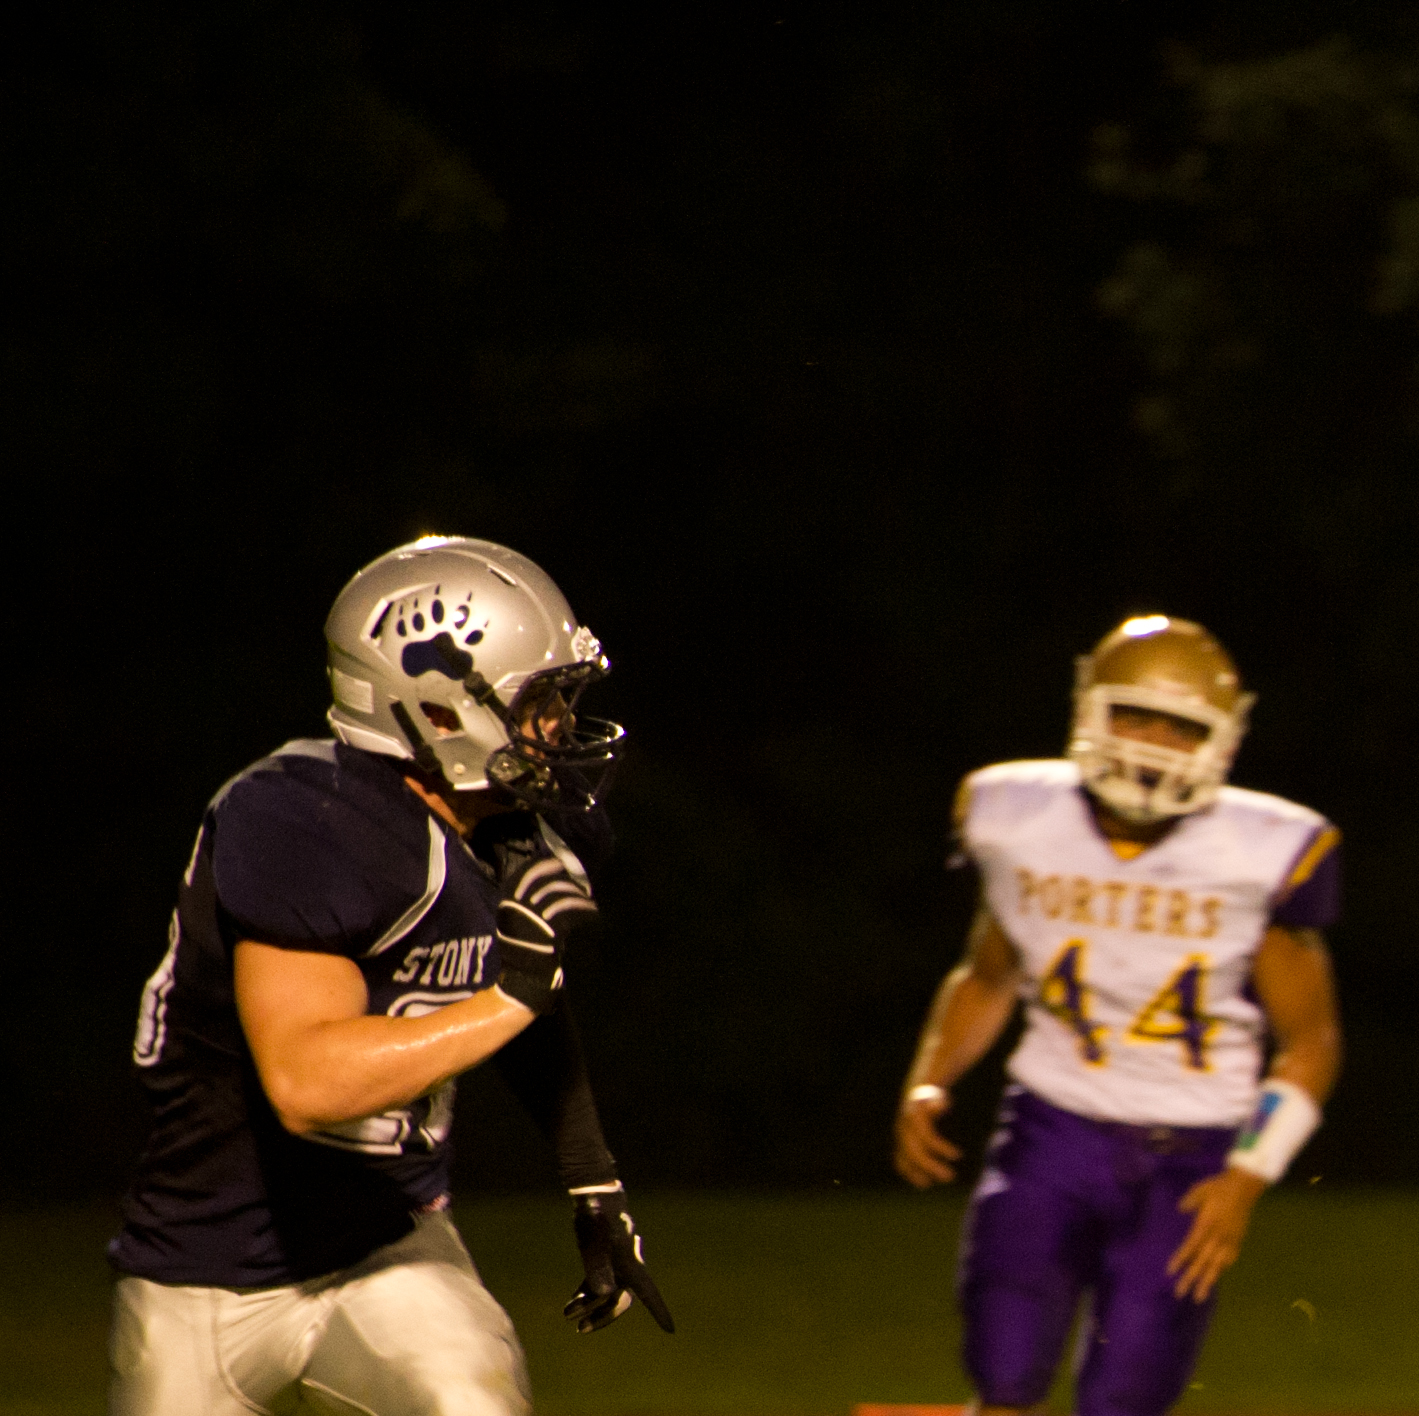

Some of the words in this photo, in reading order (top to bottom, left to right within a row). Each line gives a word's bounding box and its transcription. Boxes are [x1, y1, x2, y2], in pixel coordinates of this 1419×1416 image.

[1015, 867, 1221, 939] PORTERS
[393, 935, 492, 987] STONY
[1040, 937, 1219, 1074] 44
